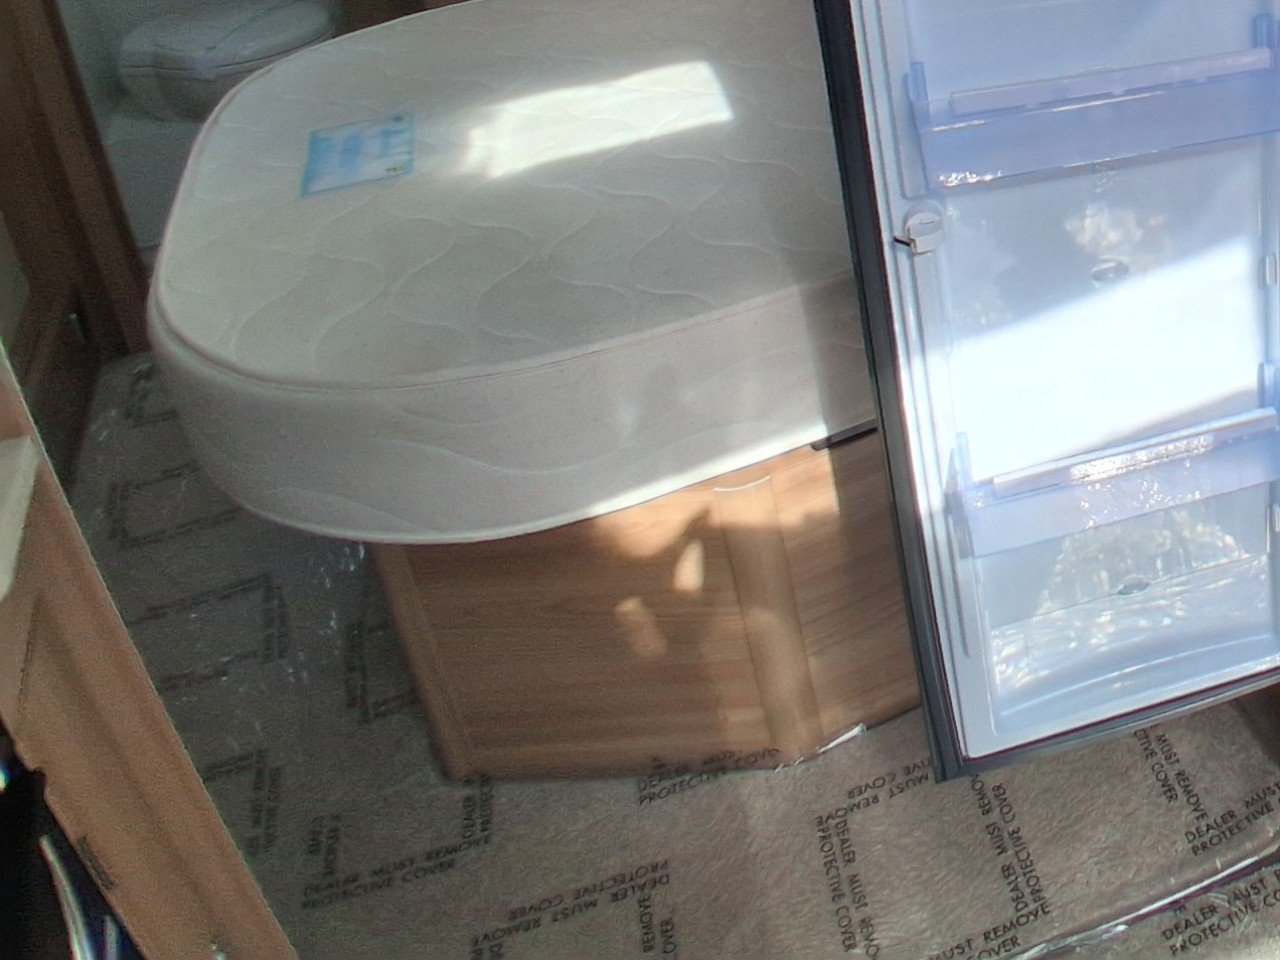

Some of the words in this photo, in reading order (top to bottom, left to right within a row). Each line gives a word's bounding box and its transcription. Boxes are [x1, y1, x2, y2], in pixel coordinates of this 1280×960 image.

[848, 772, 896, 799] COVER
[889, 772, 929, 799] MUST
[1133, 728, 1158, 760] CTIVE
[1151, 762, 1179, 803] COVER
[1155, 733, 1180, 765] MUST
[1175, 769, 1210, 822] REMOVE
[816, 796, 880, 826] REMOVE
[971, 773, 993, 816] REMO
[992, 783, 1016, 824] COVER
[985, 821, 1008, 856] MUST
[1185, 809, 1238, 844] DEALER
[1192, 802, 1275, 856] PROTECTIVE
[573, 858, 668, 902] PROTECTIVE
[1007, 826, 1046, 903] PROTECTIVE
[508, 893, 565, 922] COVER
[610, 873, 670, 904] DEALER
[818, 826, 846, 903] PROTECTIVE
[836, 905, 857, 953] COVER
[835, 819, 857, 868] DEALER
[849, 872, 869, 911] MUST
[859, 916, 880, 960] REMO
[1001, 862, 1029, 913] DEALER
[551, 898, 600, 924] MUST
[982, 902, 1052, 944] REMOVE
[1161, 903, 1219, 941] DEALER
[1170, 900, 1260, 956] PROTECTIVE
